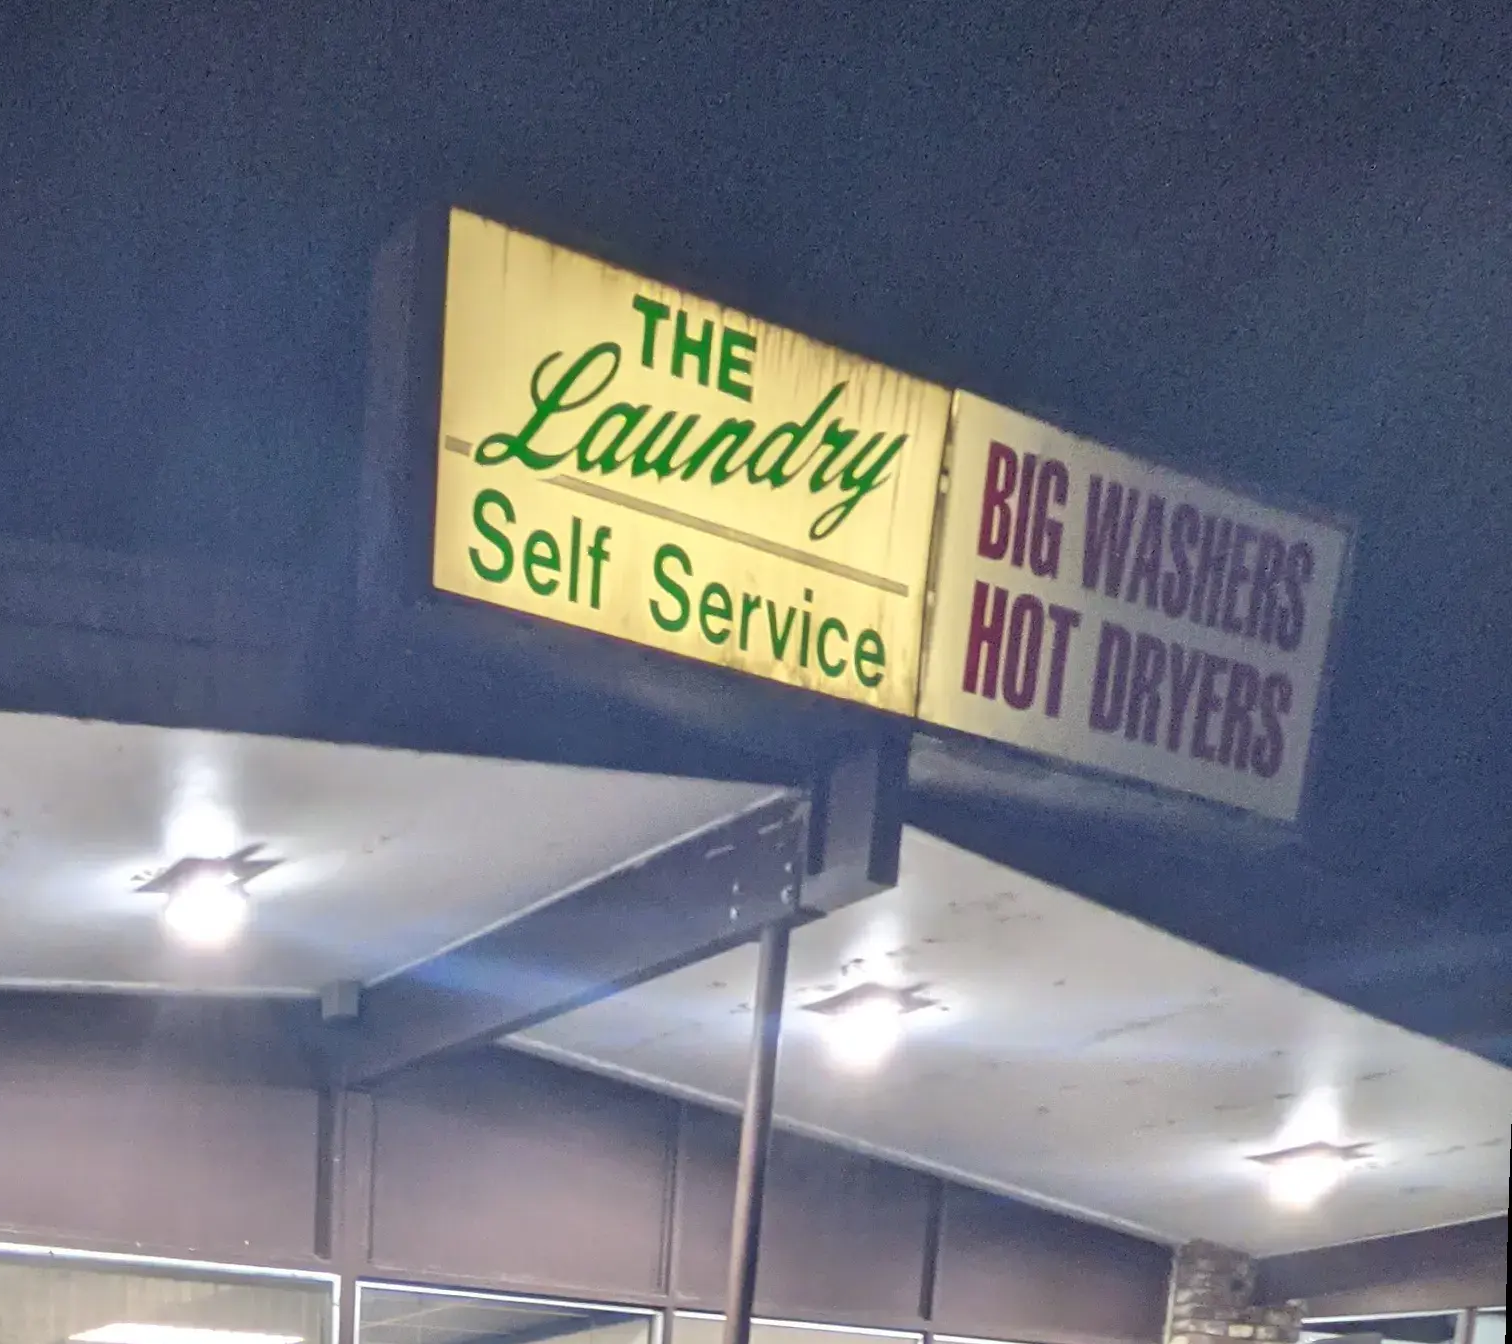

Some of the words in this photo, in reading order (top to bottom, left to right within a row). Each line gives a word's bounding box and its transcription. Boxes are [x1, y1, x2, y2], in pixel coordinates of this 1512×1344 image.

[474, 342, 908, 539] Laundry
[632, 294, 758, 401] THE
[468, 488, 611, 610] Self
[651, 544, 887, 689] Service
[976, 440, 1069, 580] BIG
[1084, 472, 1317, 653] WASHERS
[962, 581, 1081, 719] HOT
[1090, 625, 1294, 779] DRYERS
